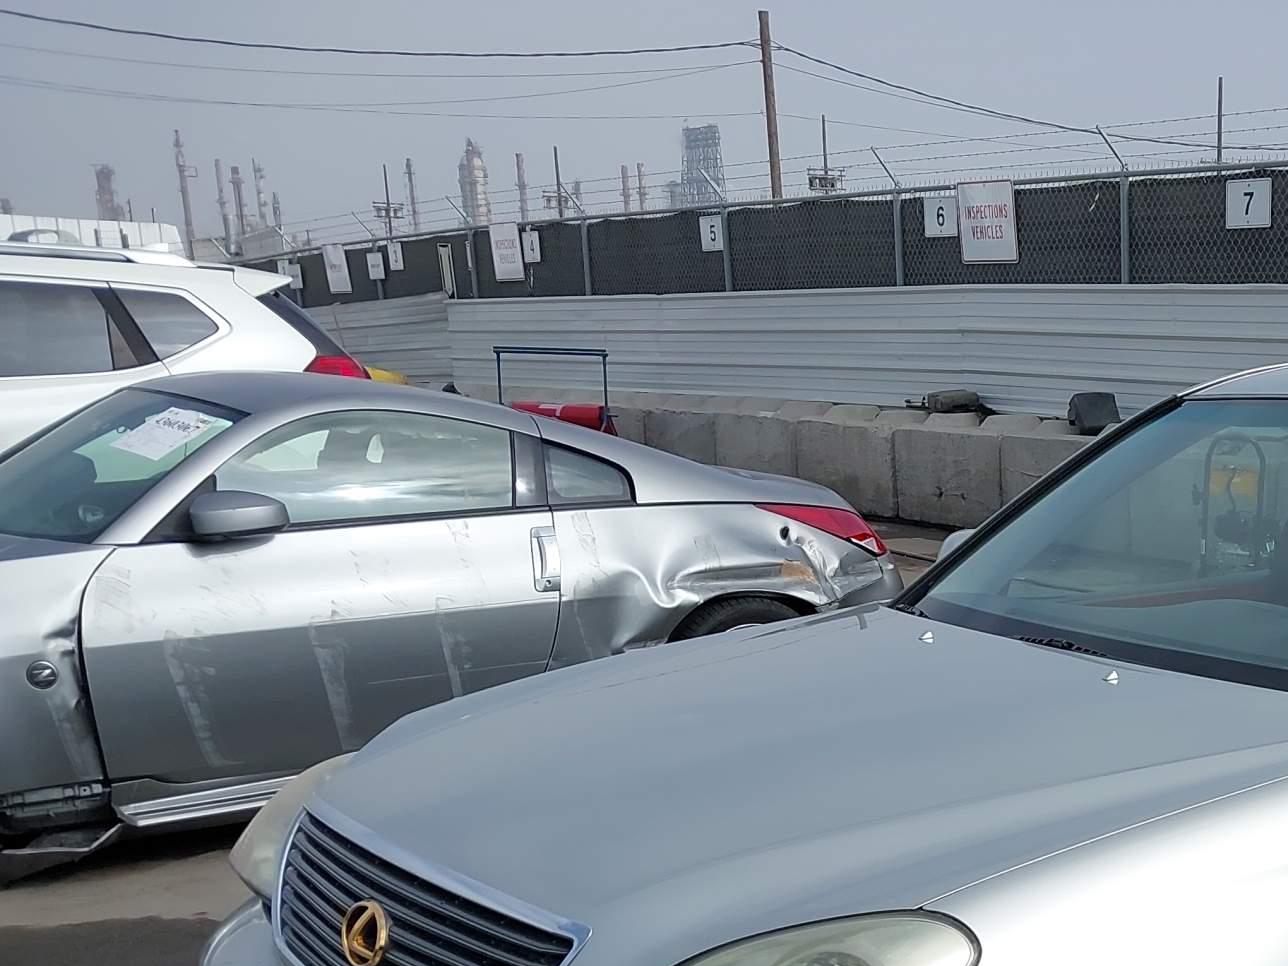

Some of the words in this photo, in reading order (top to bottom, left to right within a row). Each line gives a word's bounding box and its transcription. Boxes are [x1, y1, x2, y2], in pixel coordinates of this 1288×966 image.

[964, 203, 1008, 220] INSPECTIONS
[1243, 191, 1255, 216] 7
[936, 206, 945, 227] 6
[709, 224, 717, 242] 5
[971, 224, 1004, 240] VEHICLES
